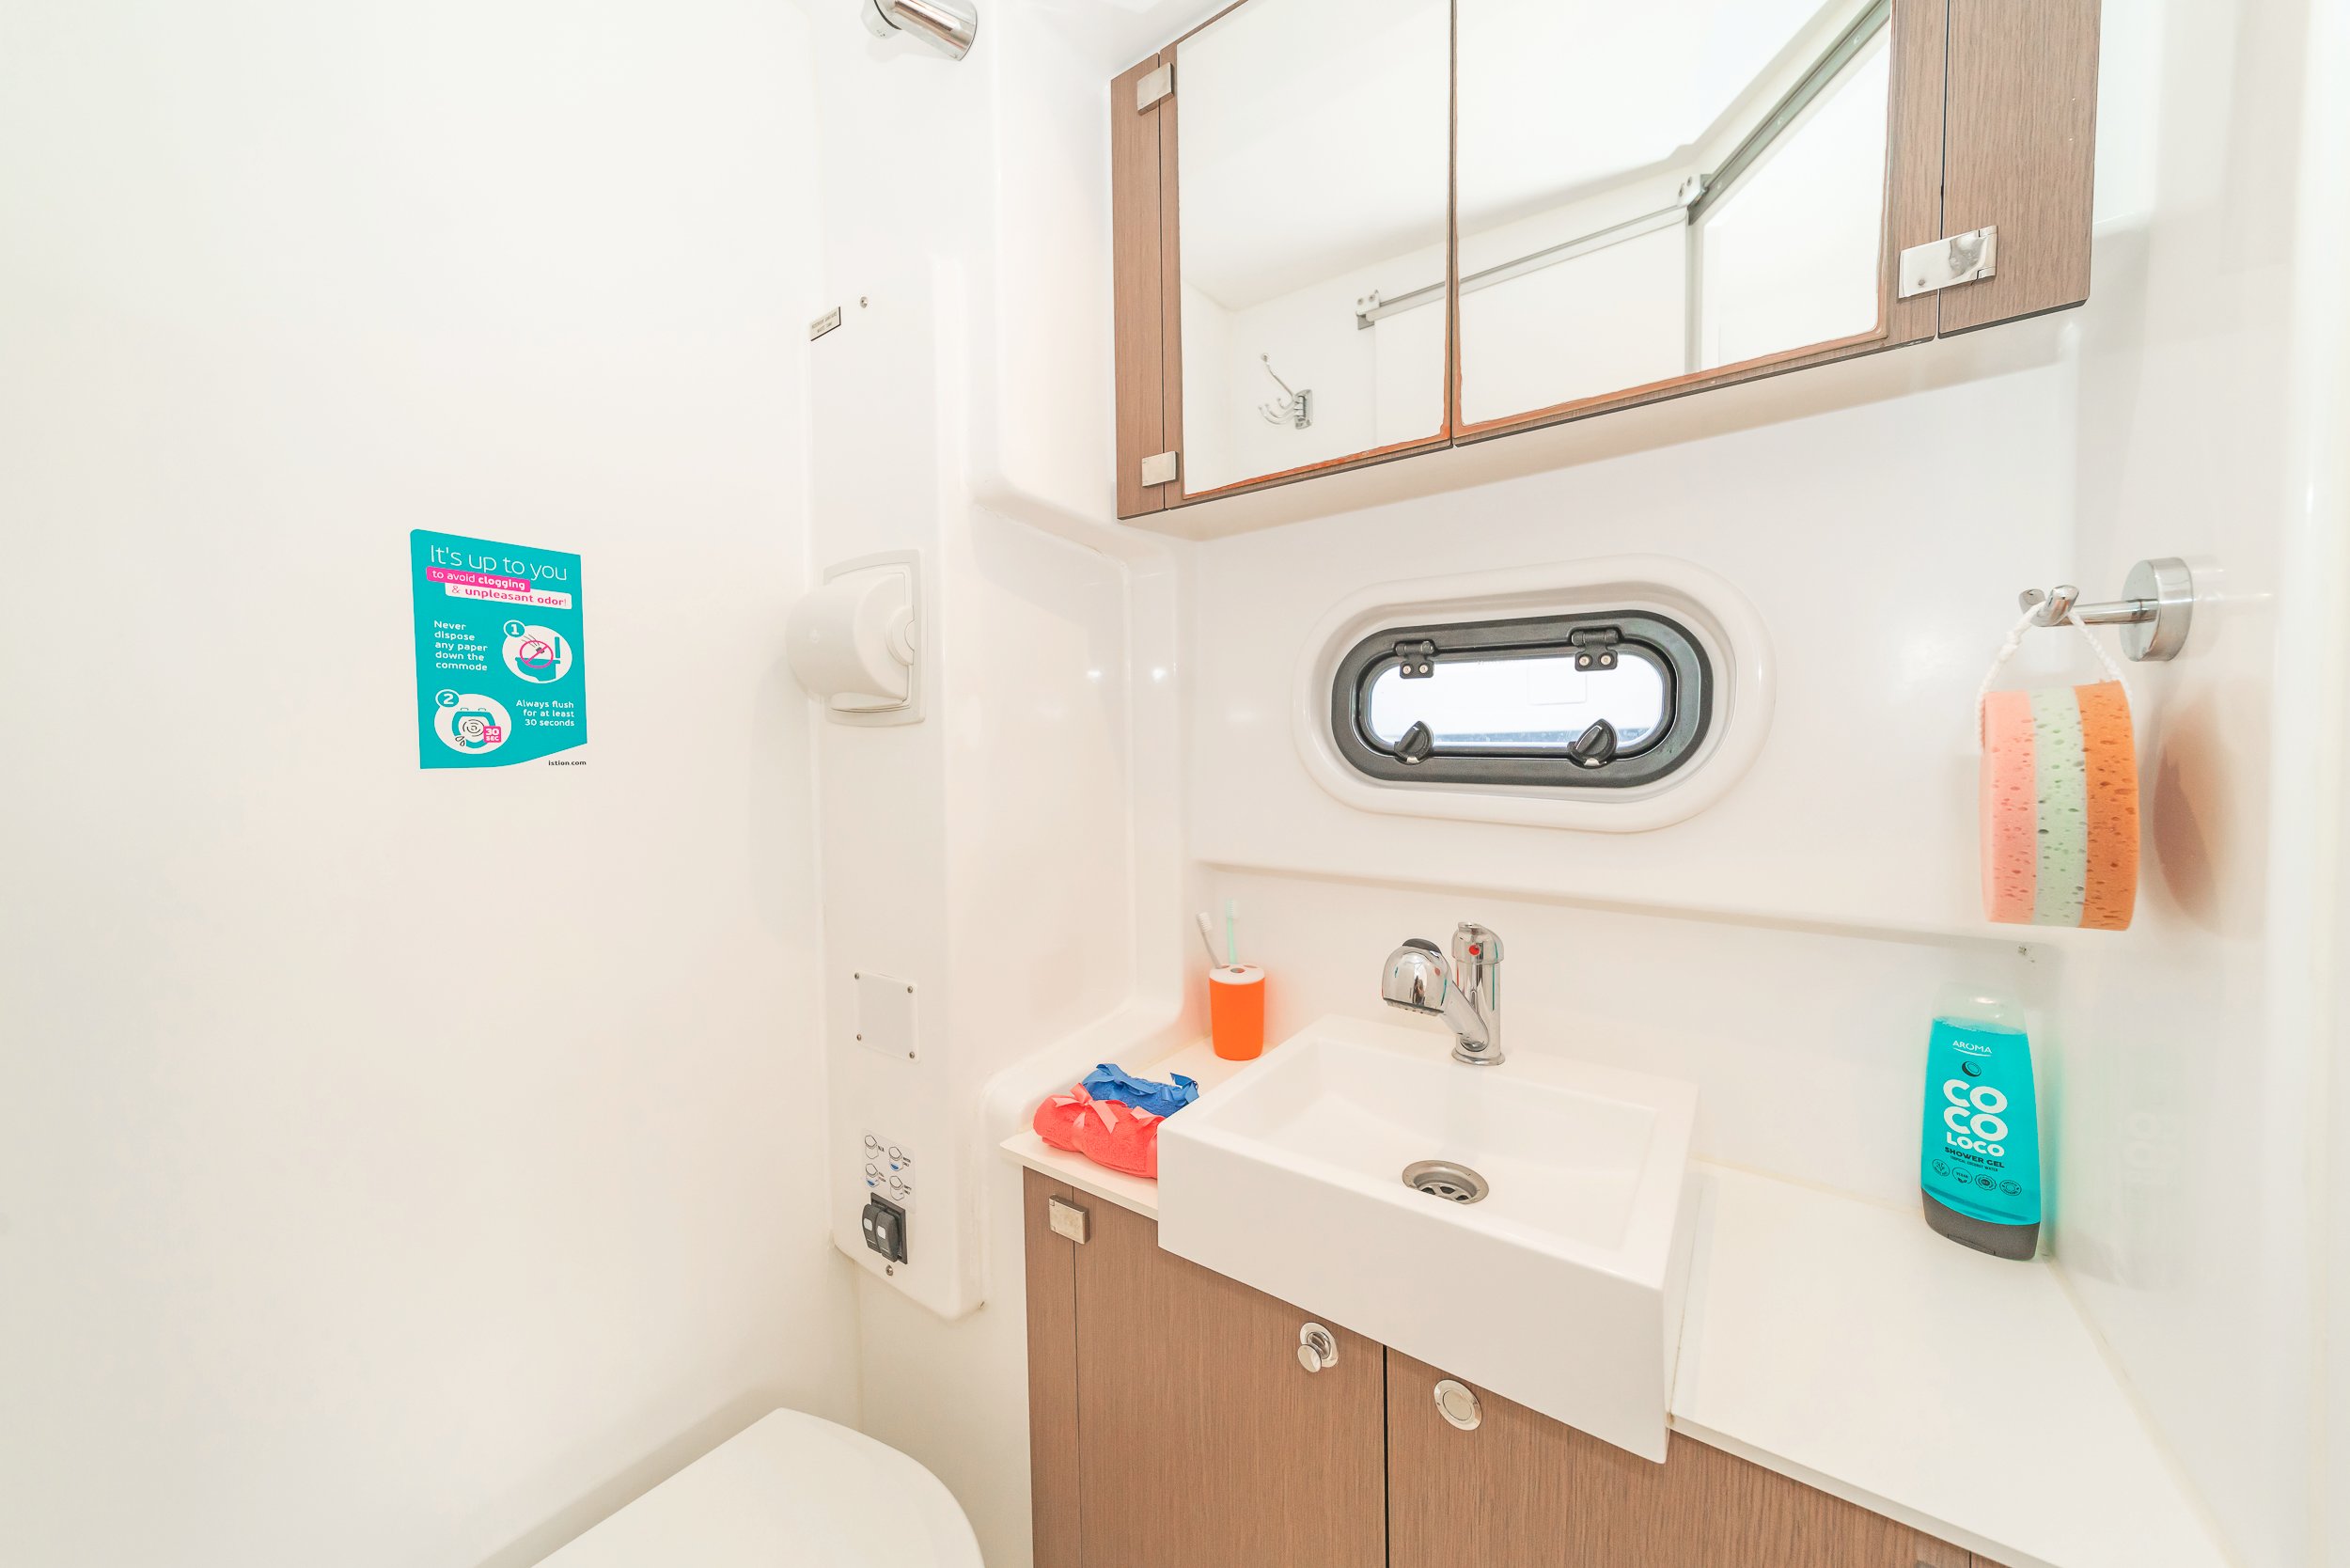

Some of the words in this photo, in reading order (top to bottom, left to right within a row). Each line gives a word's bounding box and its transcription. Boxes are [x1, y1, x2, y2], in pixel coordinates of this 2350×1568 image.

[431, 544, 462, 567] It's
[468, 554, 497, 572] up
[502, 557, 525, 575] to
[530, 563, 567, 581] you
[431, 570, 445, 579] to
[446, 572, 476, 583] avoid
[478, 576, 525, 590] clogging
[451, 585, 461, 594] &
[464, 588, 534, 603] unpleasant
[537, 596, 567, 606] odor!
[433, 619, 466, 631] Never
[510, 624, 519, 635] 1
[434, 631, 476, 641] dispose
[434, 642, 455, 651] any
[457, 644, 488, 654] paper
[435, 651, 464, 660] down
[467, 651, 485, 662] the
[435, 661, 488, 671] commode
[443, 694, 454, 705] 2
[515, 699, 550, 709] Always
[552, 700, 574, 709] flush
[523, 709, 538, 717] for
[552, 710, 575, 718] least
[525, 718, 537, 727] 30
[539, 718, 575, 727] seconds
[485, 728, 500, 736] 30
[1952, 1040, 1993, 1054] AROMA
[1942, 1078, 2008, 1114] CO
[1943, 1105, 2009, 1142] CO
[1946, 1131, 2005, 1157] LOCO
[1944, 1146, 1984, 1164] SHOWER
[1986, 1159, 2005, 1168] GEL
